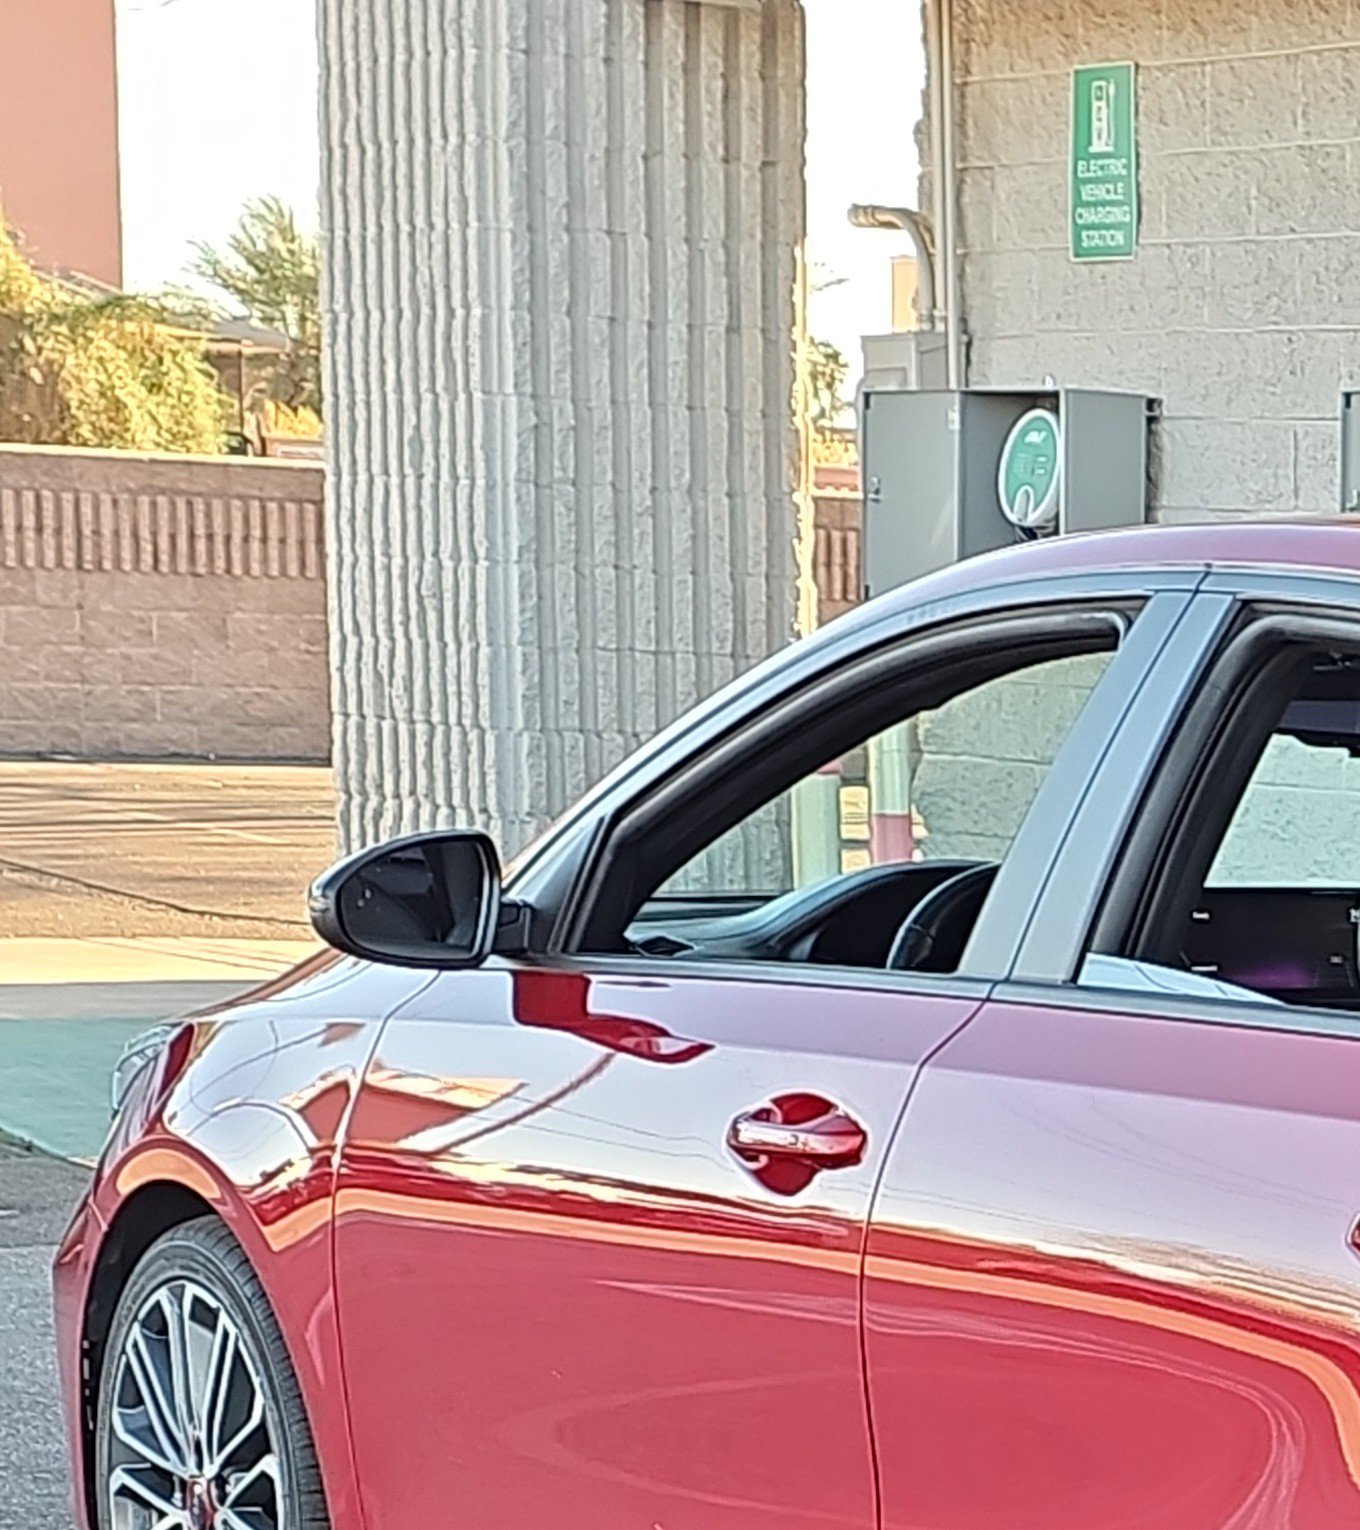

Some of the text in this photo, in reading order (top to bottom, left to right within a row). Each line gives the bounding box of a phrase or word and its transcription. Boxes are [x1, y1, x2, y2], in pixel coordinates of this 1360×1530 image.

[1078, 159, 1128, 178] ELECTRIC
[1080, 182, 1124, 201] VEHICLE
[1075, 205, 1130, 225] CHARGING
[1081, 230, 1124, 247] STATION
